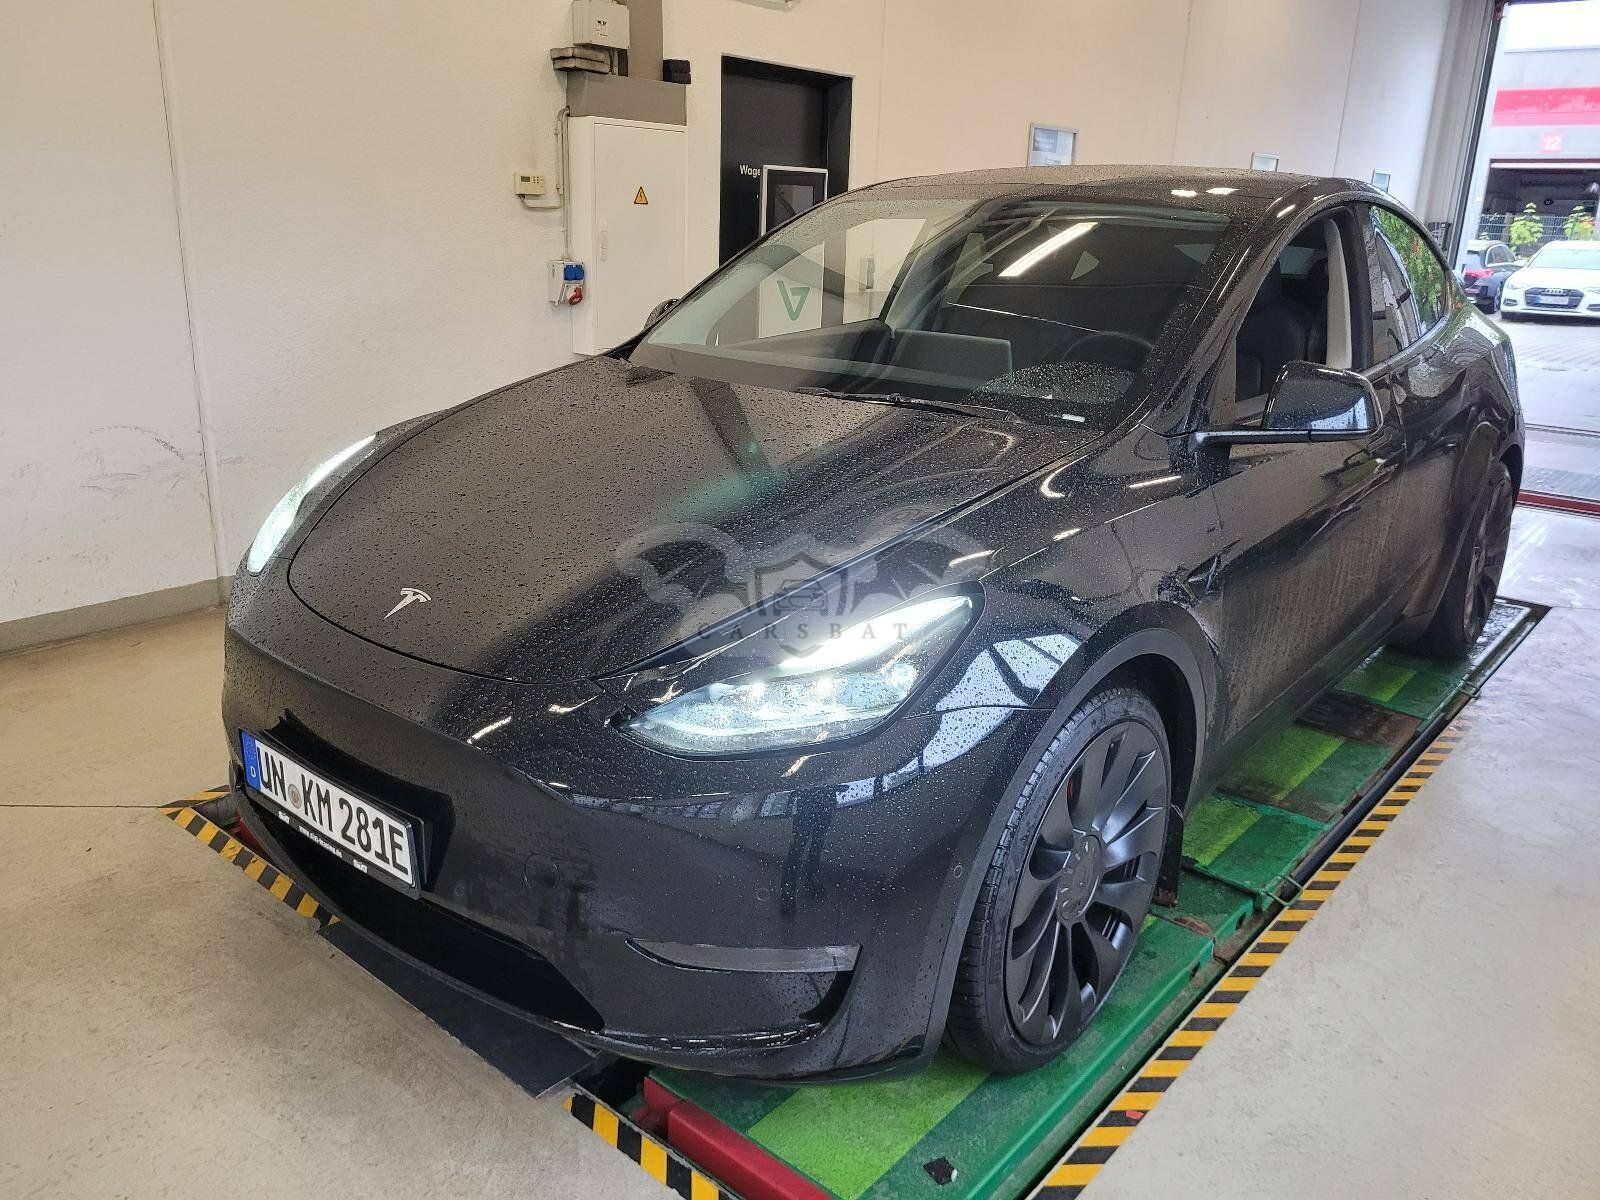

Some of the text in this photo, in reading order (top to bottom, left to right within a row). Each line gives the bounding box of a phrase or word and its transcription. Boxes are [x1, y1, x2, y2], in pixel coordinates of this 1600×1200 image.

[250, 766, 256, 778] D
[257, 746, 287, 801] UN
[301, 773, 333, 832] KM
[340, 797, 409, 875] 281E
